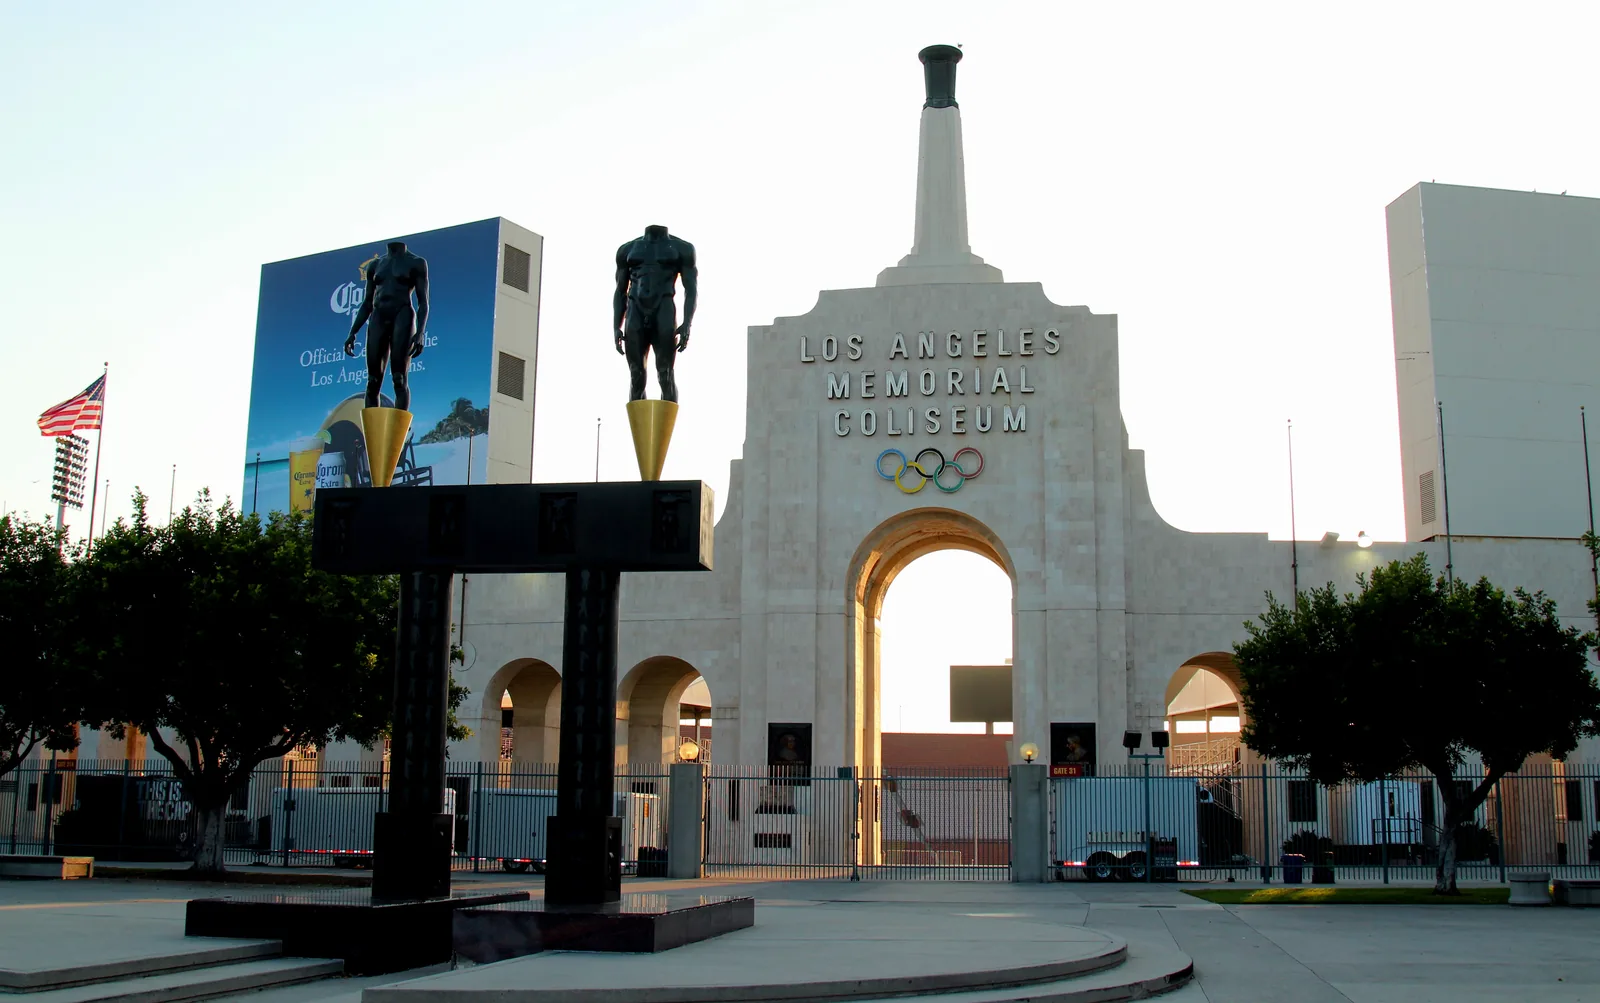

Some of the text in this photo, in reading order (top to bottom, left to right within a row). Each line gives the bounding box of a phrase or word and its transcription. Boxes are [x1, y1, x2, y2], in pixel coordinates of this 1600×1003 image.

[423, 331, 438, 348] he
[800, 327, 1061, 363] LOS ANGELES
[300, 345, 346, 368] Official
[310, 366, 369, 388] Los Ange
[827, 365, 1035, 400] MEMORIAL
[833, 404, 1027, 437] COLISEUM
[320, 478, 340, 488] Extra
[1053, 767, 1077, 775] GATE 31
[168, 781, 183, 801] IS
